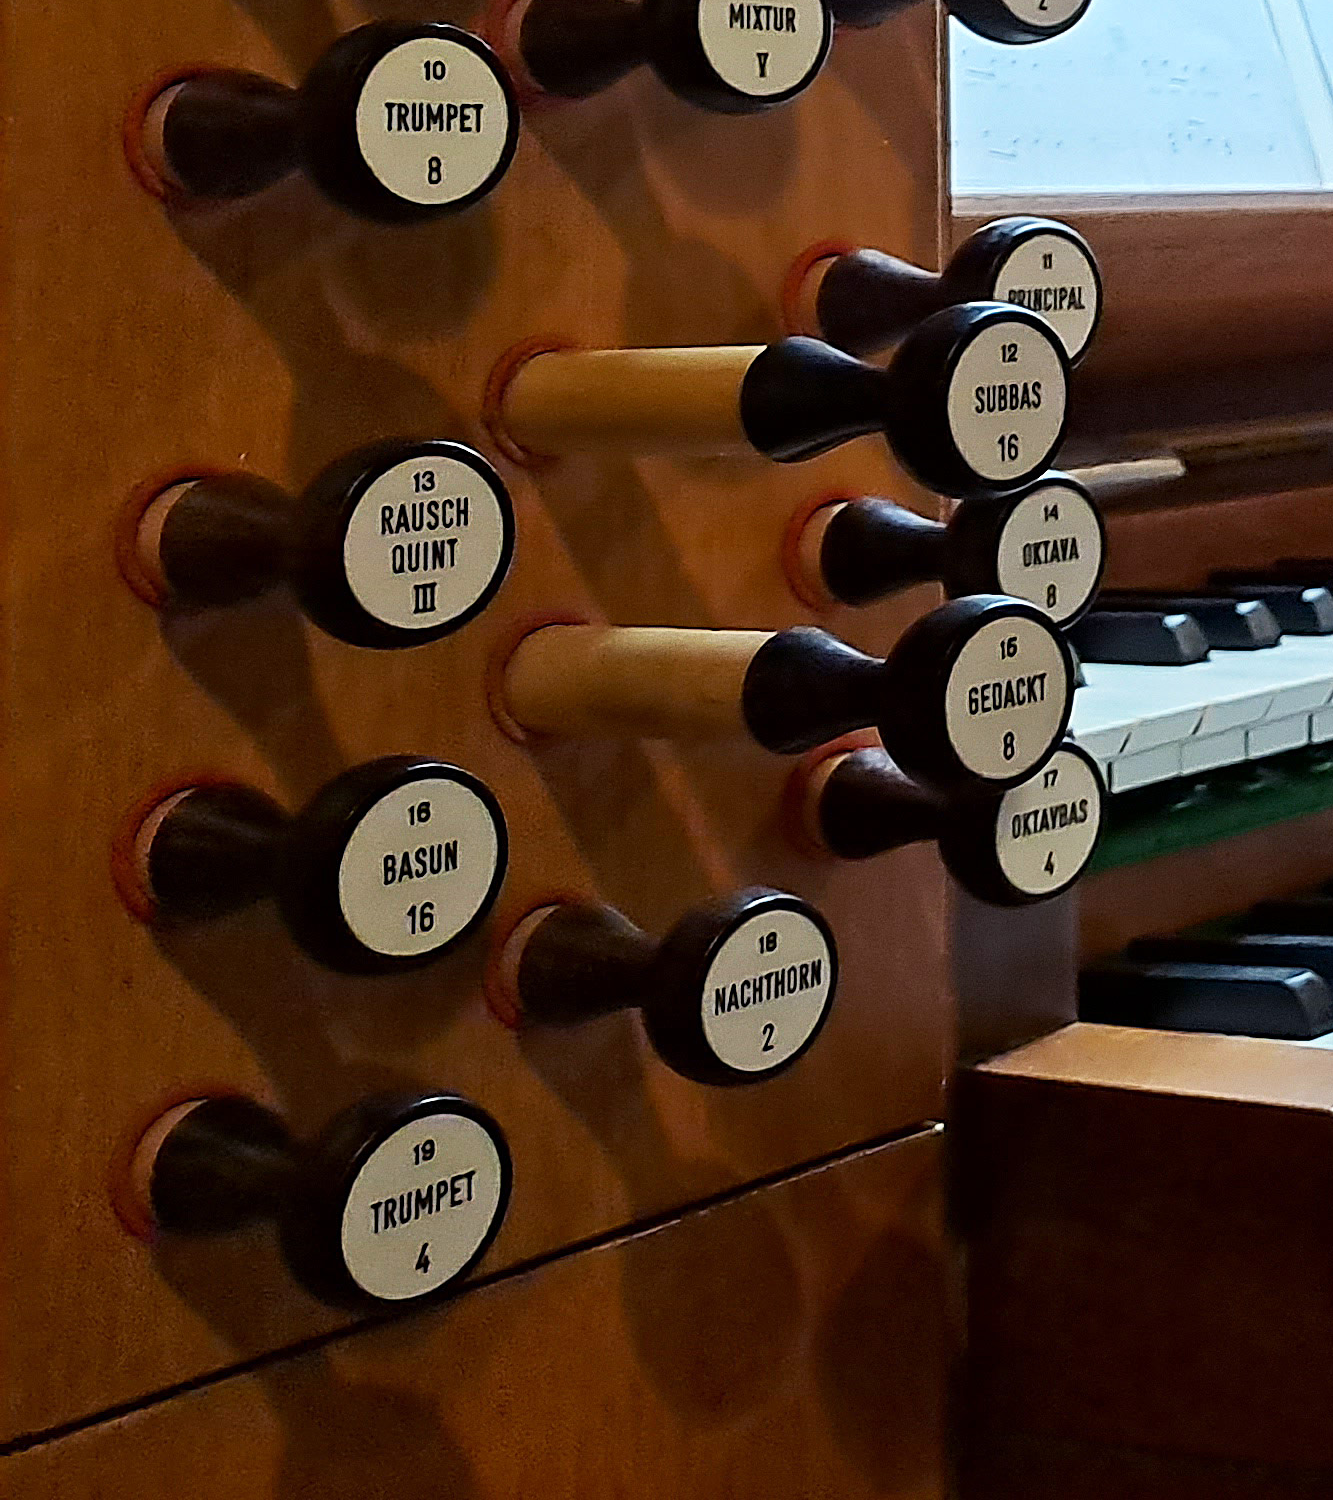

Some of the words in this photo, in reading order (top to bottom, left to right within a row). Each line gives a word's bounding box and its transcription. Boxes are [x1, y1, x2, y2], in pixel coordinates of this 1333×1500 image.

[728, 2, 797, 34] MIXTUR
[423, 59, 447, 82] 10
[384, 101, 485, 134] TRUMPET
[427, 155, 443, 185] 8
[1041, 251, 1053, 270] 11
[1000, 342, 1019, 364] 12
[974, 380, 1042, 415] SUBBAS
[996, 433, 1019, 463] 16
[412, 470, 436, 494] 13
[380, 496, 469, 537] RAUSCH
[1043, 502, 1059, 524] 14
[391, 537, 459, 575] QUINT
[1022, 536, 1081, 568] OKTAVA
[411, 580, 438, 616] III
[1045, 583, 1057, 609] 8
[999, 635, 1018, 661] 15
[968, 672, 1048, 716] GEDACKT
[1002, 731, 1016, 761] 8
[1042, 768, 1059, 790] 17
[1011, 798, 1089, 840] OKTAVBAS
[382, 839, 459, 886] BASUN
[1043, 850, 1055, 878] 4
[406, 901, 435, 935] 16
[758, 931, 778, 955] 18
[714, 958, 822, 1017] NACHTHORN
[761, 1022, 775, 1053] 2
[412, 1138, 436, 1166] 19
[368, 1168, 478, 1235] TRUMPET
[414, 1241, 432, 1274] 4
